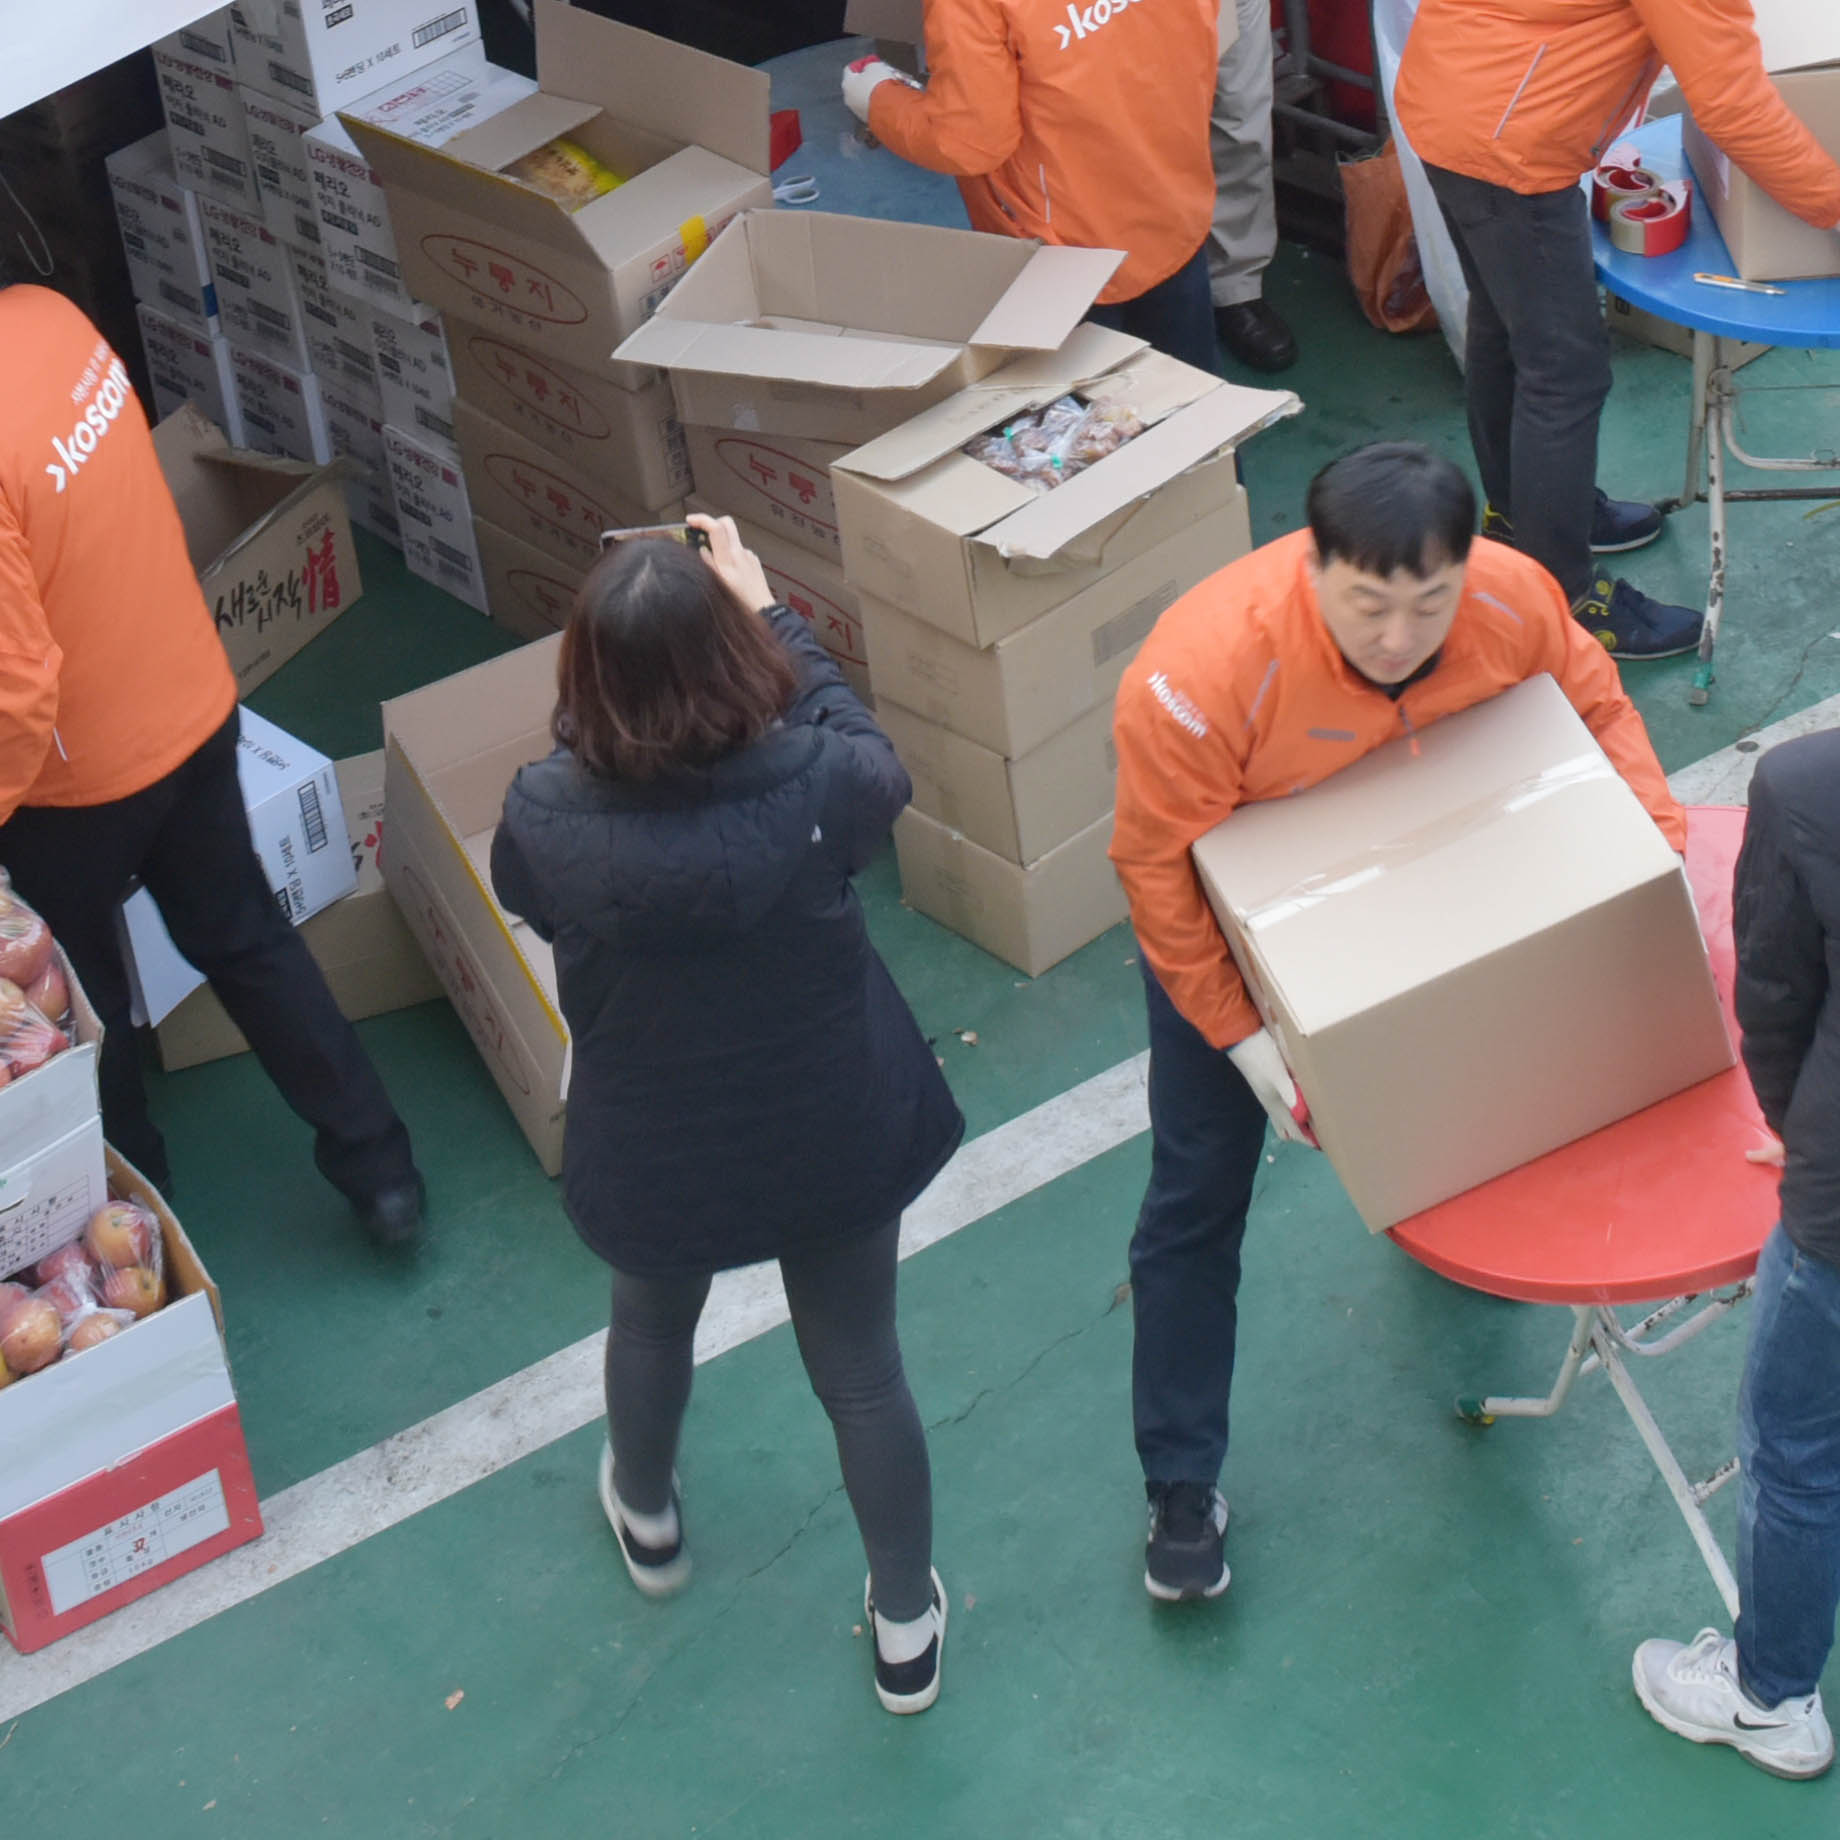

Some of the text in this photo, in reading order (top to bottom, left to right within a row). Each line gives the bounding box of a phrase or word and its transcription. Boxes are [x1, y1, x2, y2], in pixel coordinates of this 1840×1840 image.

[452, 248, 554, 312] 누룽지
[495, 351, 582, 426] 누룽지
[749, 452, 818, 504] 누룽
